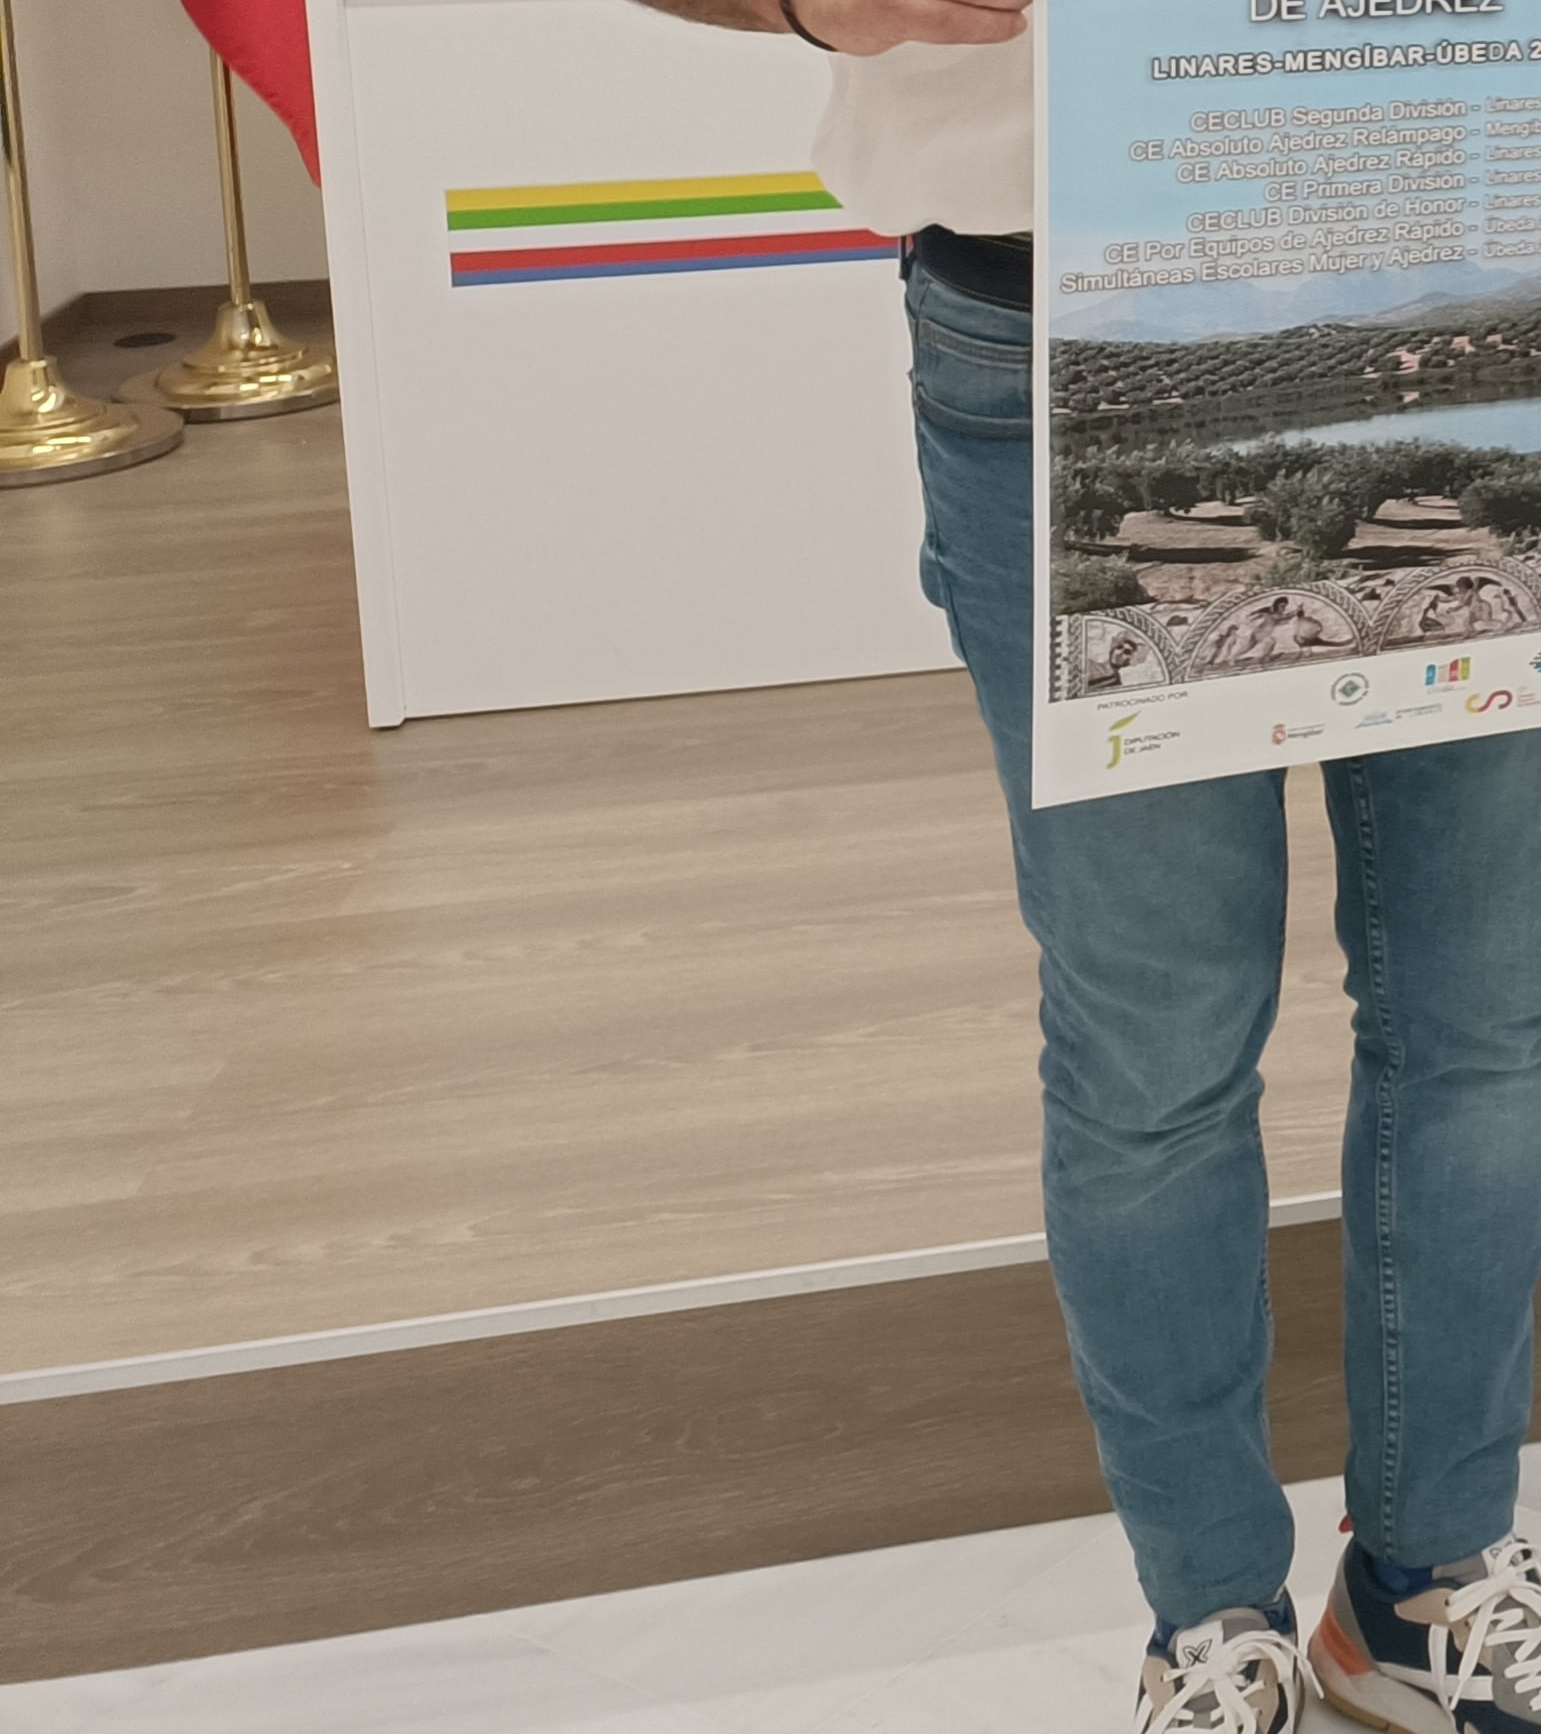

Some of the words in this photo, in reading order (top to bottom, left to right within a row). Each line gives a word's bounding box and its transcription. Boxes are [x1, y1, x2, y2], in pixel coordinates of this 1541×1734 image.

[1151, 37, 1522, 79] LINARES-MENGÍBAR-ÚBEDA
[1190, 108, 1284, 132] CECLUB
[1291, 103, 1383, 129] Segunda
[1389, 97, 1466, 120] División
[1128, 140, 1163, 162] CE
[1168, 135, 1261, 159] Absoluto
[1267, 129, 1346, 155] Ajedrez
[1352, 122, 1466, 150] Relámpago
[1176, 162, 1209, 183] CE
[1215, 157, 1307, 180] Absoluto
[1312, 151, 1390, 177] Ajedrez
[1395, 146, 1466, 171] Rápido
[1263, 181, 1297, 202] CE
[1302, 176, 1382, 199] Primera
[1388, 170, 1465, 193] División
[1186, 207, 1282, 233] CECLUB
[1287, 201, 1368, 225] División
[1372, 198, 1399, 219] de
[1404, 194, 1465, 216] Honor
[1105, 244, 1139, 265] CE
[1144, 240, 1184, 261] Por
[1188, 233, 1274, 261] Equipos
[1278, 231, 1305, 251] de
[1311, 225, 1389, 252] Ajedrez
[1394, 218, 1465, 245] Rápido
[1060, 265, 1195, 294] Simultáneas
[1200, 256, 1303, 282] Escolares
[1308, 250, 1367, 276] Mujer
[1371, 254, 1384, 272] y
[1387, 243, 1465, 270] Ajedrez
